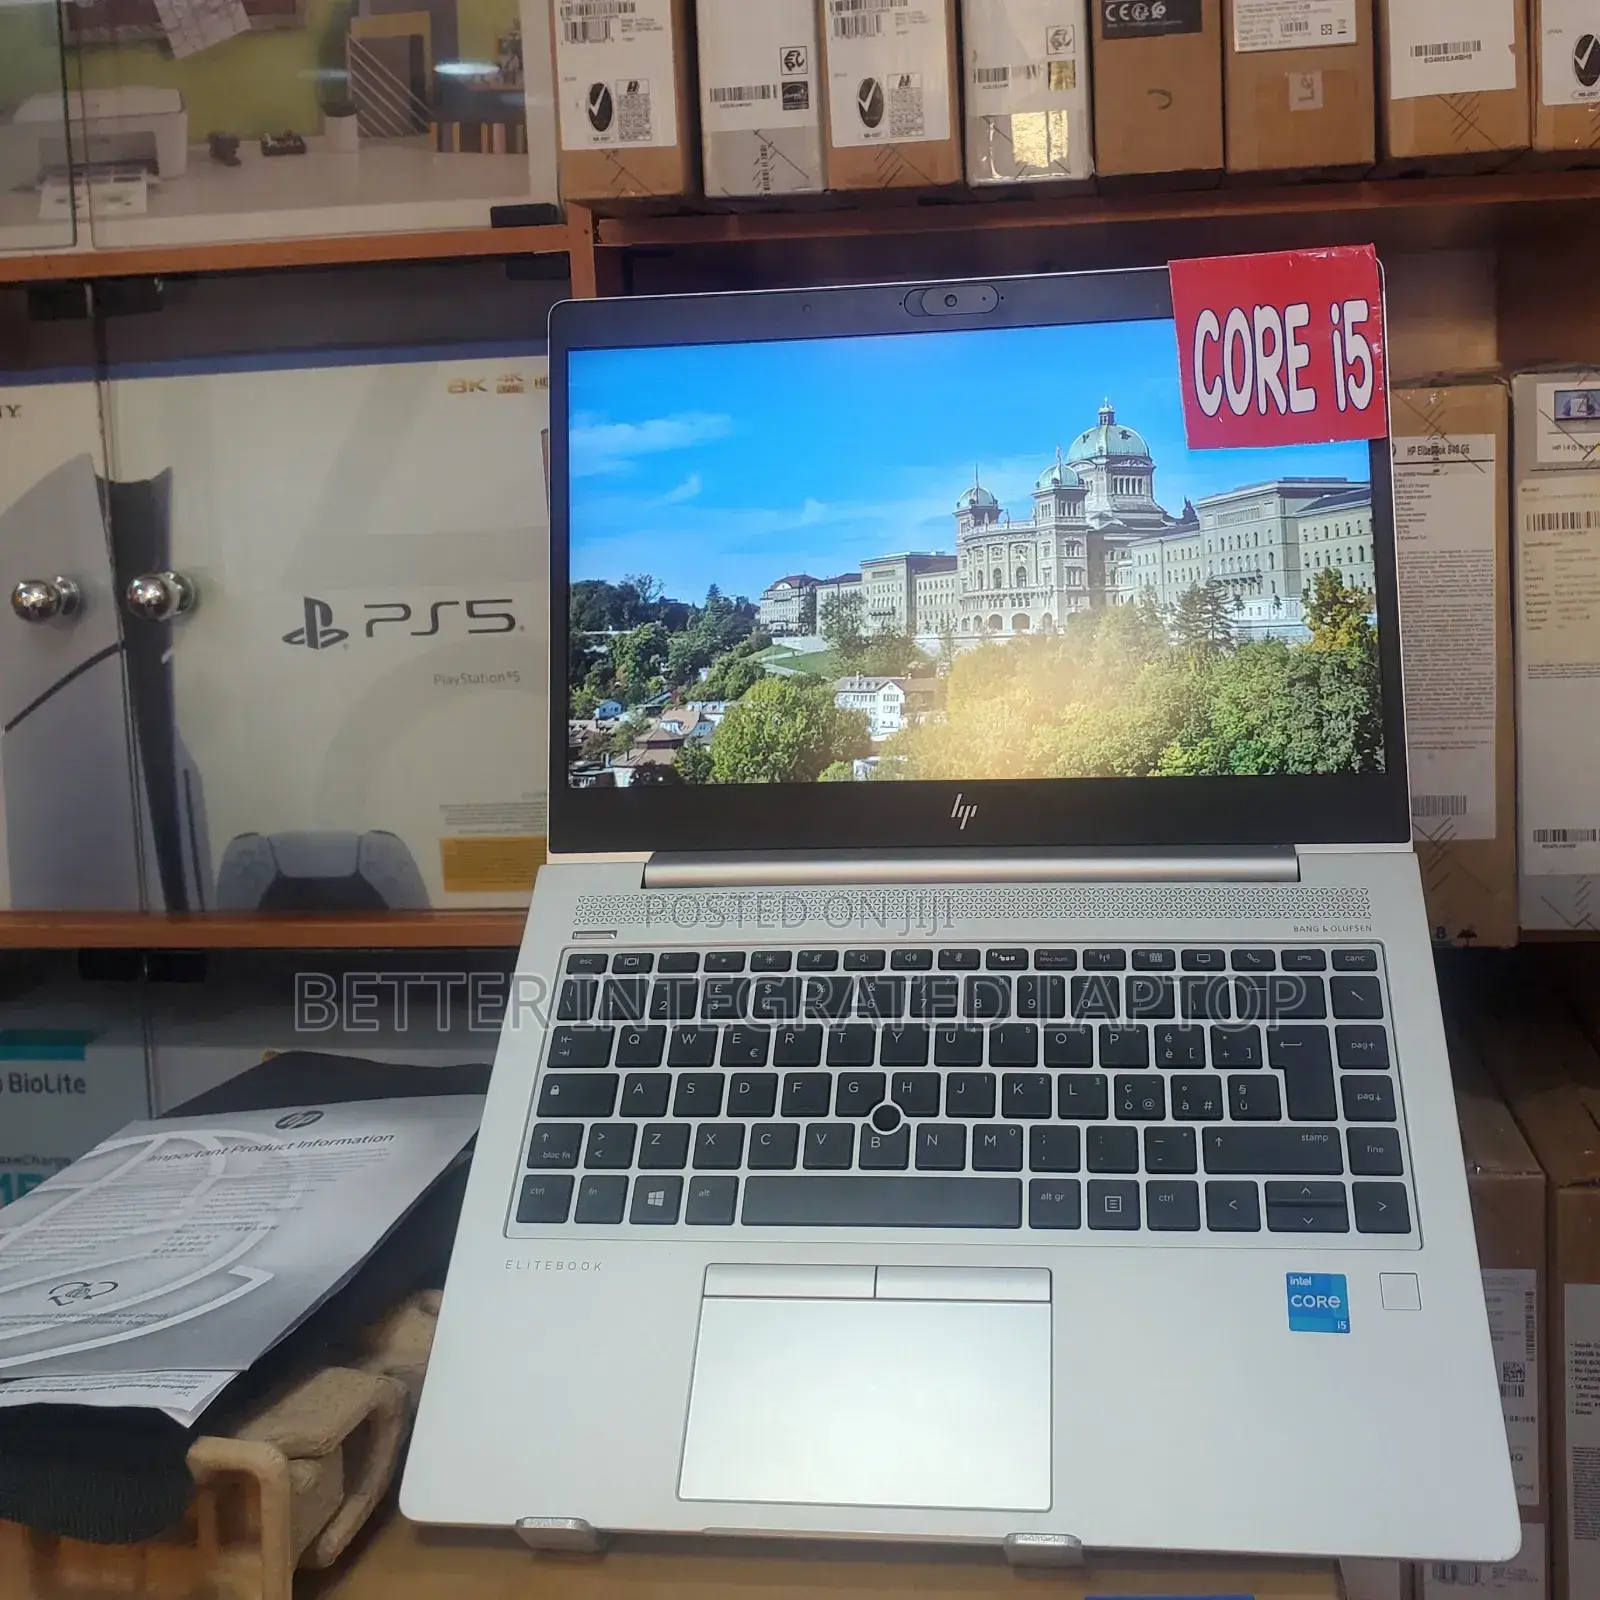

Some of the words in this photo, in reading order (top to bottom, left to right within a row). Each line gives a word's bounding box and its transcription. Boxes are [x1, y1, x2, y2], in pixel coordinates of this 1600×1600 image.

[1194, 301, 1317, 417] CORE
[1330, 298, 1374, 412] i5
[364, 598, 517, 638] PS5
[1293, 925, 1320, 933] BANG
[1330, 924, 1373, 933] OLUFSEN
[714, 984, 723, 993] £
[765, 983, 772, 994] $
[816, 983, 825, 993] %
[868, 982, 876, 992] &
[659, 1001, 668, 1010] 2
[710, 1000, 719, 1010] 3
[815, 1000, 823, 1009] 5
[867, 999, 876, 1009] 6
[921, 999, 928, 1009] 7
[974, 999, 982, 1008] 8
[1027, 999, 1036, 1009] 9
[628, 1034, 640, 1045] Q
[681, 1033, 697, 1044] W
[732, 1033, 742, 1044] E
[784, 1033, 795, 1044] R
[837, 1033, 847, 1044] T
[893, 1032, 903, 1043] Y
[945, 1033, 956, 1043] U
[1109, 1034, 1120, 1045] P
[750, 1048, 759, 1057] €
[8, 1072, 87, 1094] BioLite
[632, 1083, 644, 1094] A
[686, 1083, 695, 1094] S
[739, 1082, 750, 1093] D
[792, 1082, 802, 1093] F
[848, 1082, 859, 1093] G
[902, 1082, 913, 1093] H
[956, 1082, 965, 1094] J
[1013, 1083, 1024, 1095] K
[1069, 1084, 1078, 1095] L
[1142, 1098, 1155, 1109] @
[1204, 1100, 1213, 1111] #
[650, 1133, 662, 1145] Z
[705, 1133, 716, 1145] X
[760, 1134, 772, 1145] C
[816, 1133, 827, 1145] V
[870, 1137, 881, 1148] B
[927, 1134, 938, 1145] N
[984, 1135, 997, 1147] M
[1301, 1133, 1329, 1142] stamp
[149, 1147, 228, 1162] Important
[230, 1141, 295, 1155] Product
[297, 1134, 395, 1149] Information
[1366, 1145, 1384, 1154] fine
[698, 1188, 711, 1197] alt
[1040, 1192, 1052, 1200] alt
[1054, 1194, 1064, 1202] gr
[505, 1260, 602, 1271] ELITEBOOK
[1290, 1276, 1312, 1286] intel
